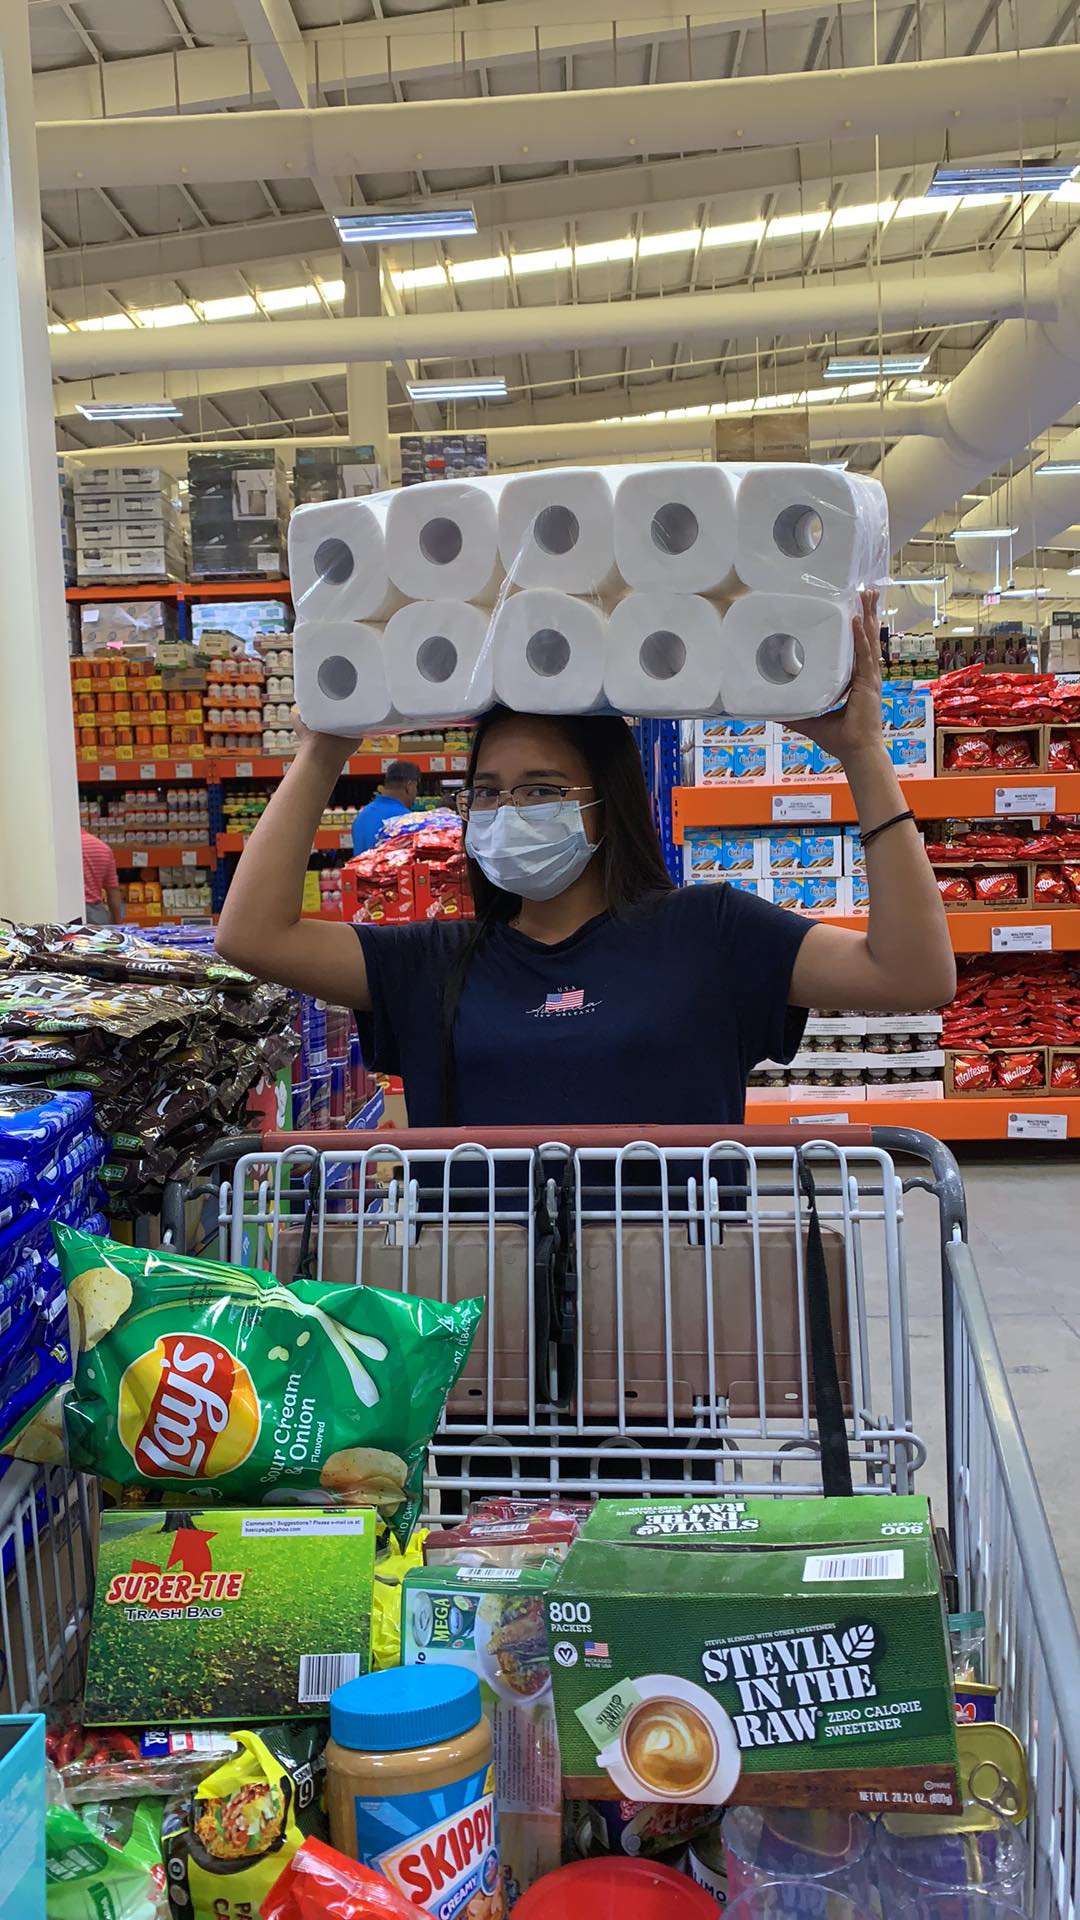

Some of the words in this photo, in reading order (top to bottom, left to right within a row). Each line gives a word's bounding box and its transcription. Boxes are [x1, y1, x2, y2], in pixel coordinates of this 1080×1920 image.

[116, 1136, 139, 1146] SIZE
[139, 1342, 229, 1476] Lay's
[260, 1449, 287, 1483] Sour
[274, 1373, 302, 1444] Cream
[289, 1398, 316, 1461] Onion
[311, 1421, 326, 1463] Flavored
[285, 1466, 304, 1475] &
[660, 1519, 760, 1534] STEVIA
[881, 1526, 924, 1536] 800
[108, 1573, 243, 1602] SUPER-TIE
[126, 1607, 183, 1620] TRASH
[187, 1607, 223, 1619] BAG
[432, 1598, 450, 1642] MEGA
[549, 1602, 591, 1623] 800
[551, 1624, 592, 1633] PACKETS
[701, 1634, 849, 1683] STEVIA
[736, 1676, 783, 1712] IN
[785, 1664, 877, 1705] THE
[827, 1710, 861, 1723] ZERO
[864, 1701, 922, 1718] CALORIE
[733, 1706, 819, 1748] RAW
[824, 1718, 902, 1737] SWEETENER
[859, 1792, 873, 1802] NET
[398, 1802, 492, 1905] SKIPPY
[440, 1872, 479, 1920] CREAMY
